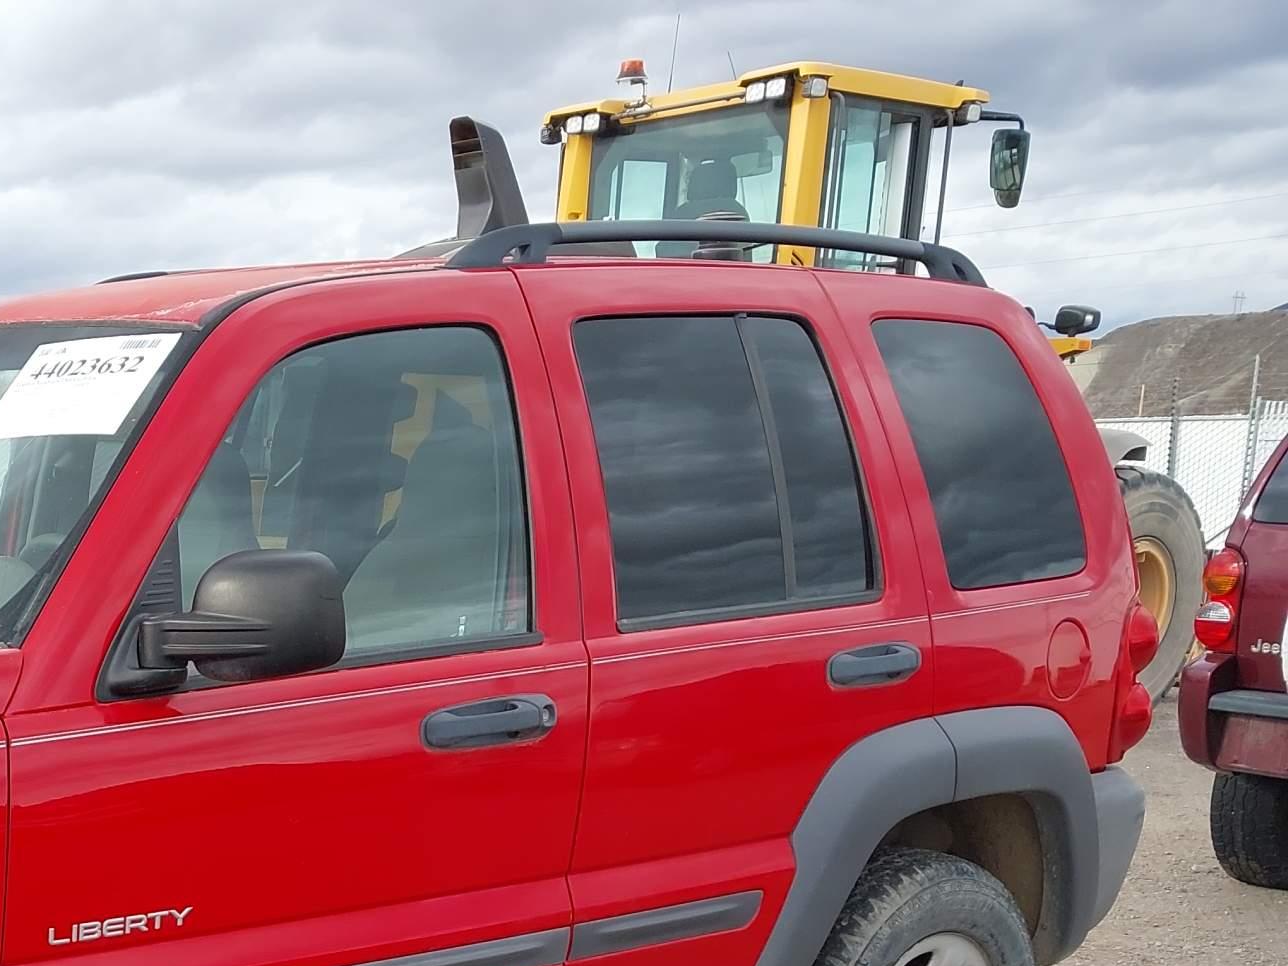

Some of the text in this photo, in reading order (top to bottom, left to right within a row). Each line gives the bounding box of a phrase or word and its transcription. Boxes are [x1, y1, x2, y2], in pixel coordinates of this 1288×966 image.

[30, 355, 144, 380] 44023632
[1250, 638, 1282, 654] Jee
[47, 905, 194, 946] LIBERTY
